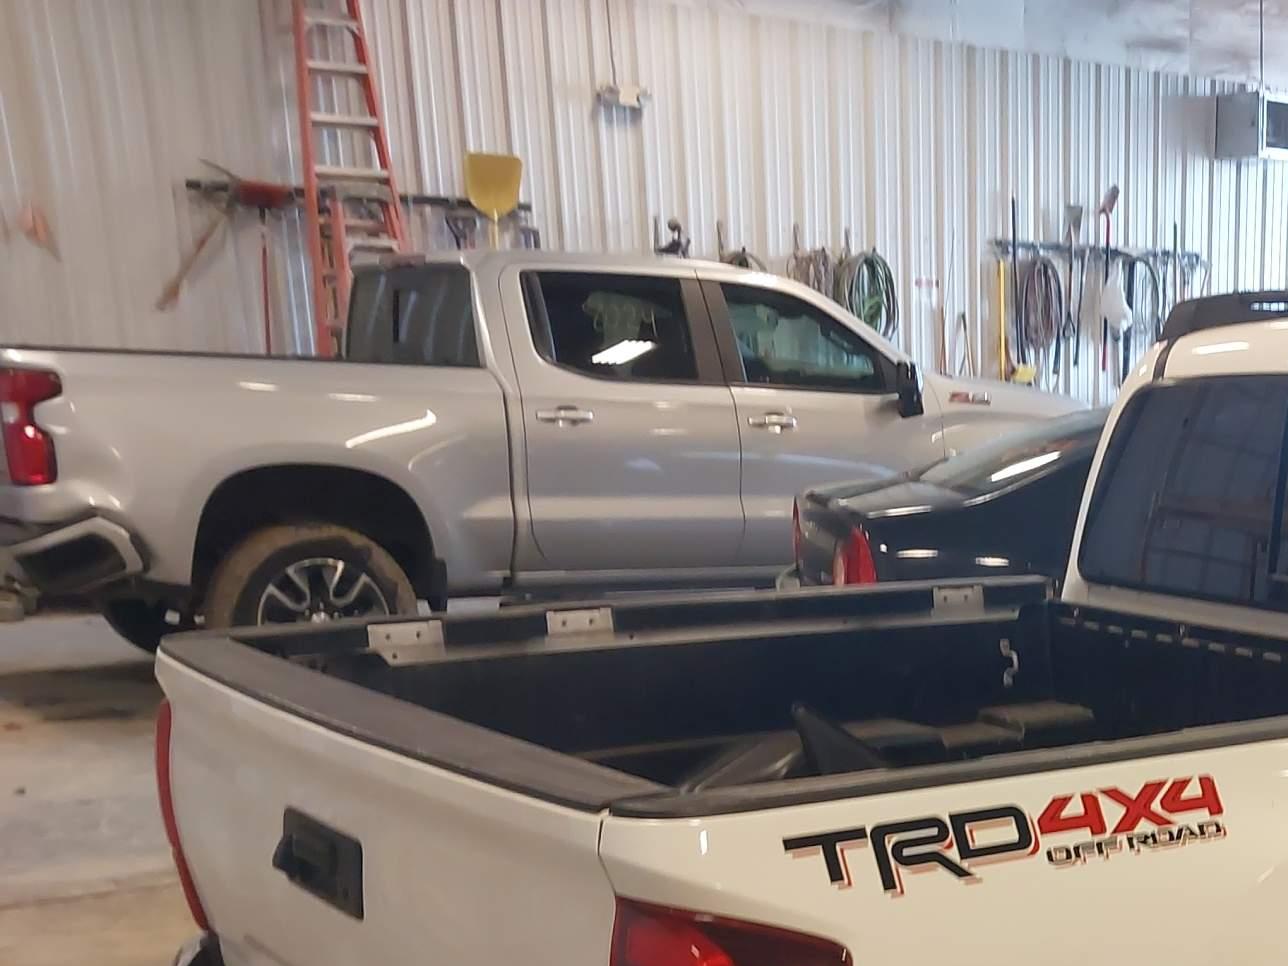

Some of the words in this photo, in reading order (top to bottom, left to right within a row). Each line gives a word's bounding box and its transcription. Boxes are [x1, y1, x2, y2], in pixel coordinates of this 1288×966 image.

[782, 804, 1040, 899] TRD
[1046, 833, 1123, 869] OFF
[1126, 819, 1228, 856] ROAD
